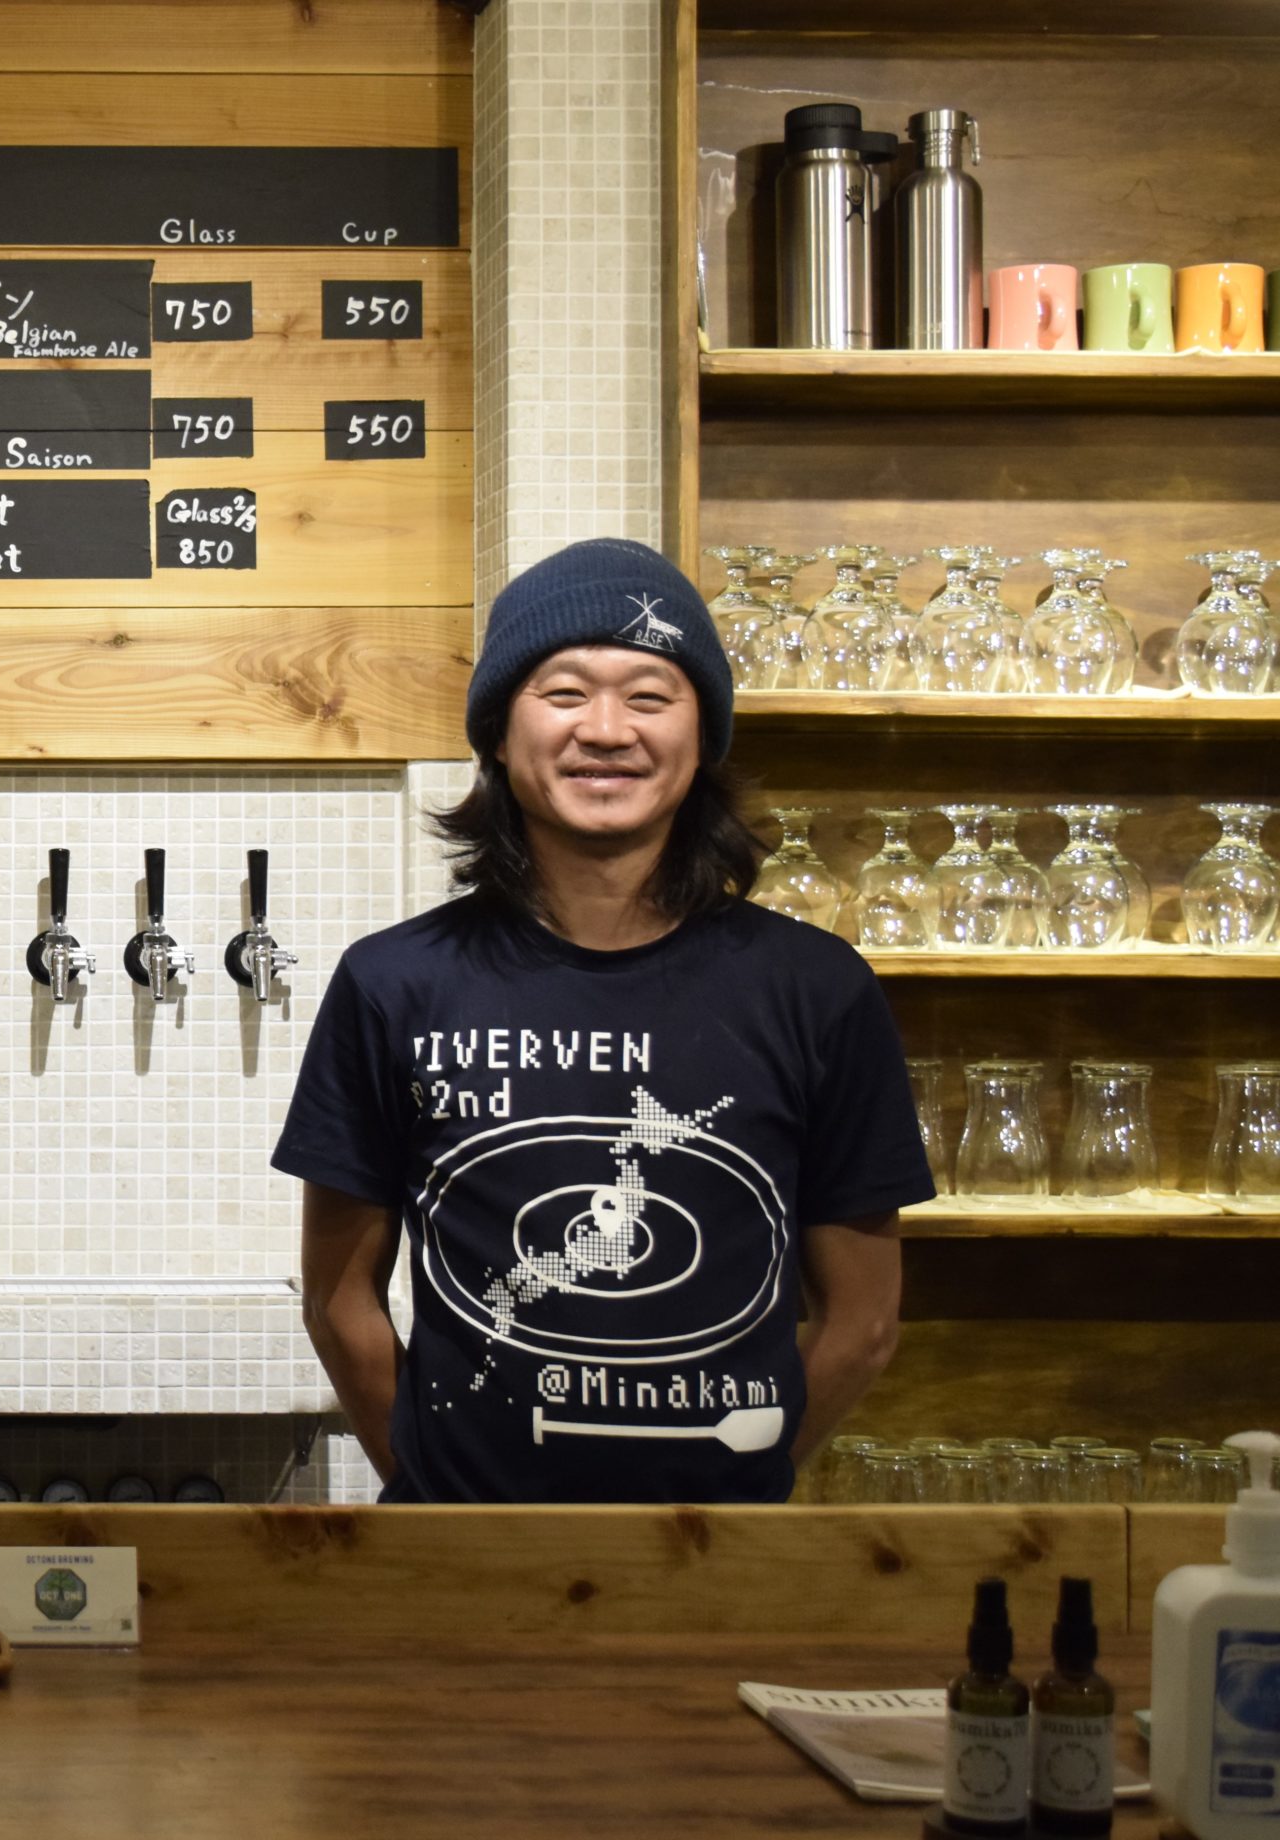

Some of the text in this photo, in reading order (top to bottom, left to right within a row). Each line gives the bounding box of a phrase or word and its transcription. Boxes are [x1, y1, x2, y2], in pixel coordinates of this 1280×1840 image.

[159, 218, 236, 244] Glass
[341, 222, 398, 246] Cup
[165, 298, 232, 330] 750
[345, 296, 410, 326] 550
[104, 340, 139, 358] Ale
[172, 414, 235, 449] 750
[346, 414, 413, 447] 550
[5, 436, 93, 469] Saison
[179, 538, 234, 565] 850
[537, 1364, 778, 1408] @Minakami
